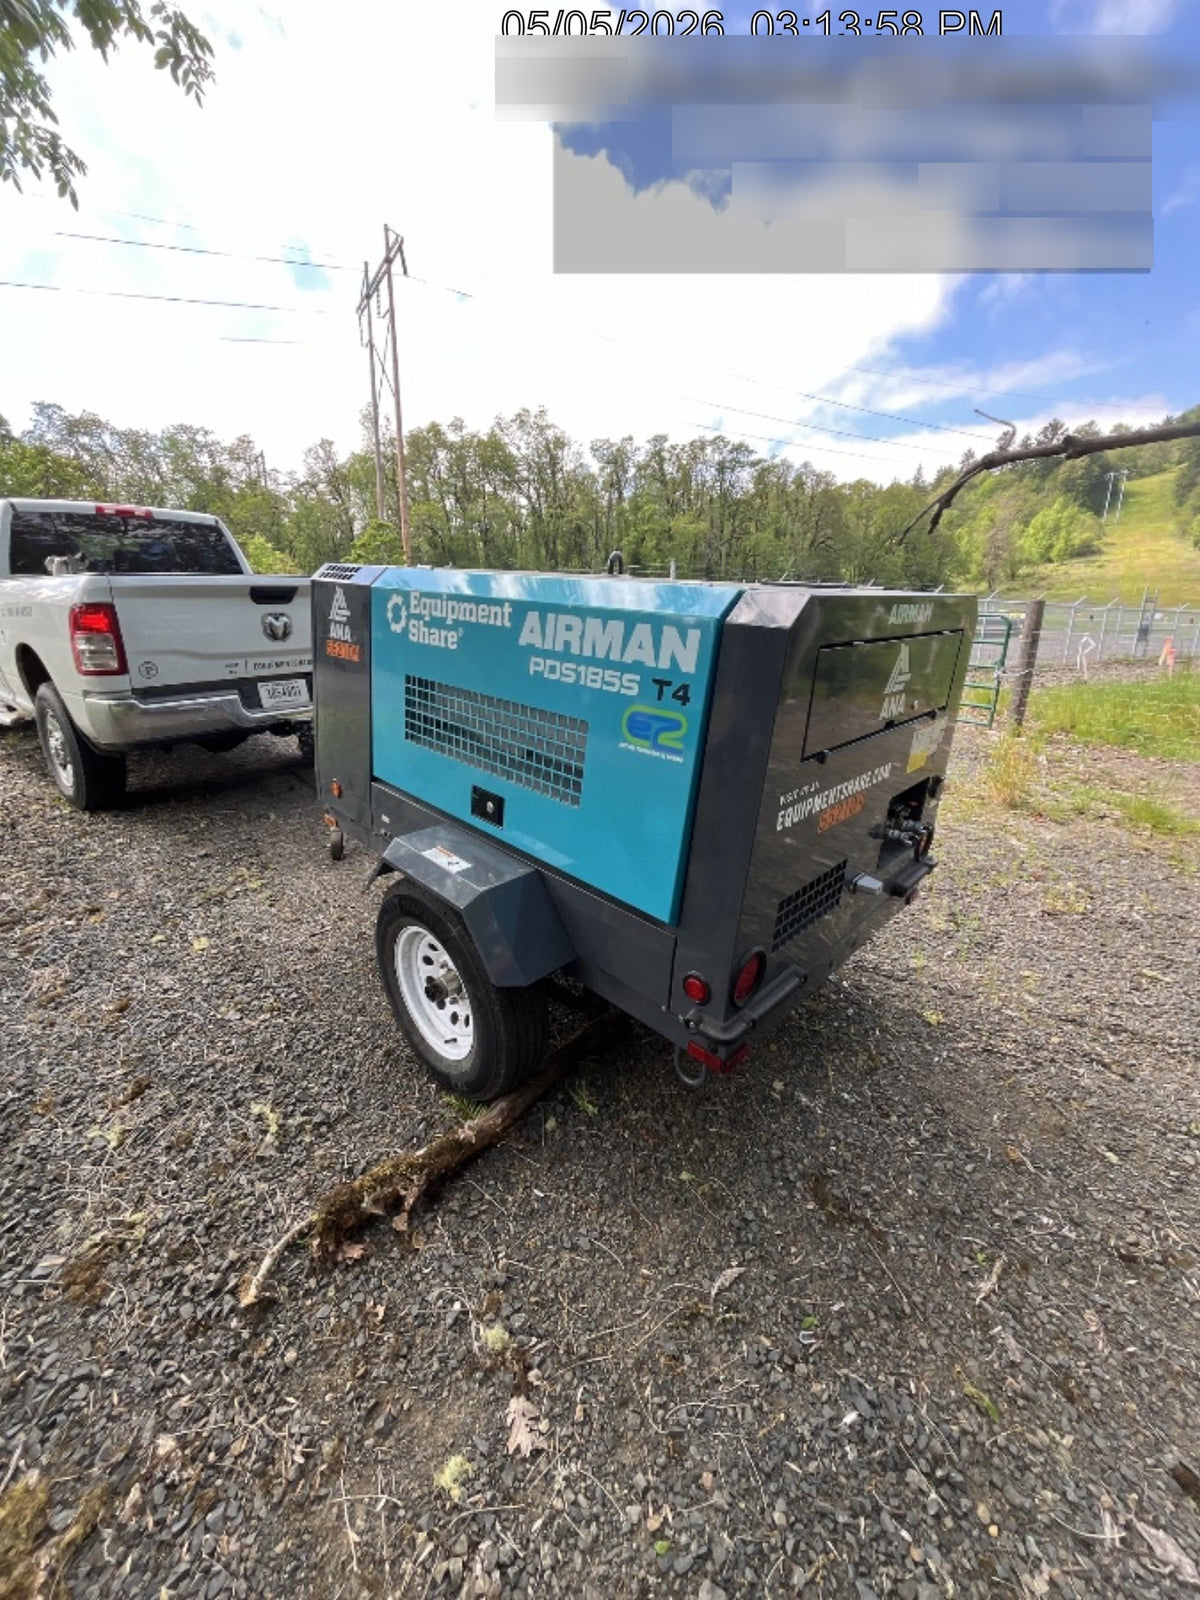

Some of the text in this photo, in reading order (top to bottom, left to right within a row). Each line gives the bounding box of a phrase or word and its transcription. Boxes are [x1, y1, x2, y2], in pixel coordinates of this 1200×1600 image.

[410, 591, 512, 627] Equipment
[888, 603, 934, 624] AIRMAN
[518, 611, 701, 674] AIRMAN
[529, 655, 691, 706] PDS185S T4
[879, 692, 906, 720] ANA
